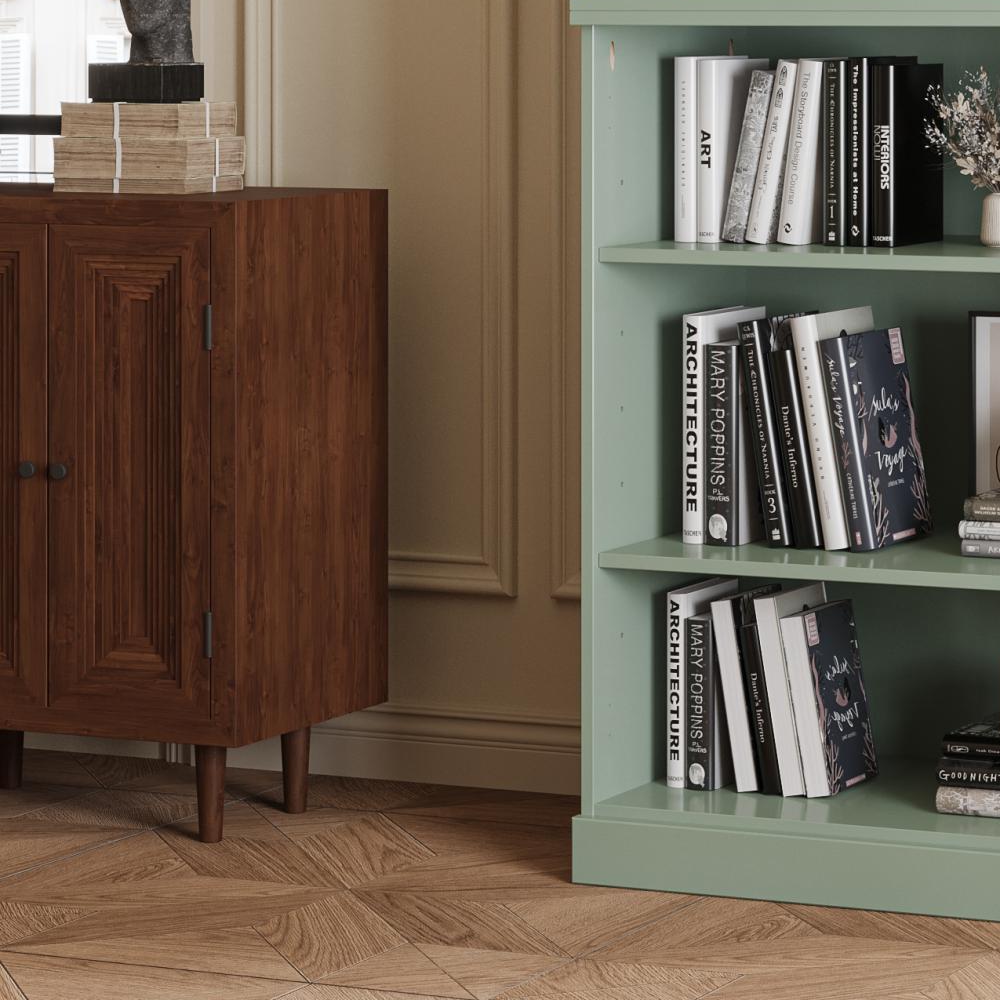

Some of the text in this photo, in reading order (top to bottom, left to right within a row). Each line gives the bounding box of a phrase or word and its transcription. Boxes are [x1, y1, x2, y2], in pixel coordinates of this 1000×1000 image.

[796, 90, 808, 138] Storyboard
[700, 130, 711, 168] ART
[791, 140, 803, 171] Design
[830, 148, 836, 157] OF
[852, 170, 858, 182] at
[880, 125, 890, 190] INTERIORS
[788, 172, 798, 205] Course
[686, 322, 698, 512] ARCHITECTURE
[710, 350, 726, 485] MARY POPPINS
[750, 370, 762, 428] CHRONICLES
[759, 430, 764, 440] OF
[762, 444, 770, 480] NARNIA
[781, 406, 799, 488] Dante's Inferno
[768, 498, 776, 514] 3
[690, 624, 703, 668] MARY
[670, 600, 680, 760] ARCHITECTURE
[690, 673, 703, 739] POPPINS
[750, 672, 764, 743] Dante's Inferno
